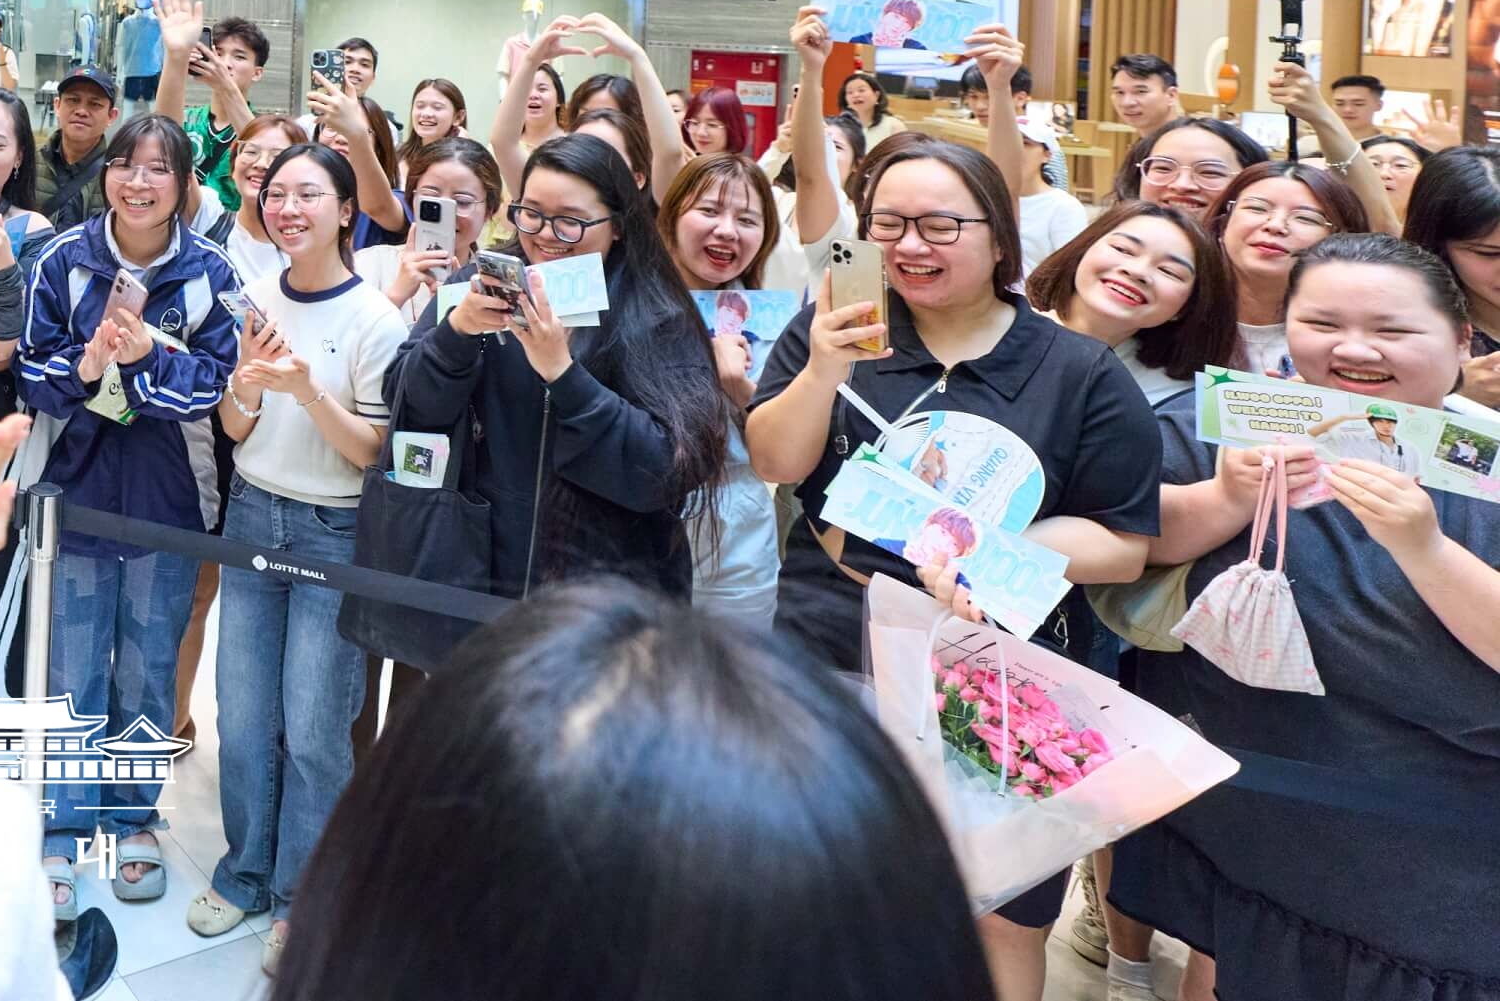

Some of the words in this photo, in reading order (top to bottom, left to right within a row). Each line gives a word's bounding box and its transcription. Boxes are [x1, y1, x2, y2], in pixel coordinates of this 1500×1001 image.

[1272, 393, 1315, 408] OPPA
[1227, 403, 1300, 420] WELCOME
[1300, 410, 1323, 422] TO
[1248, 419, 1297, 434] HANOI
[269, 562, 299, 575] LOTTE
[299, 568, 327, 581] MALL
